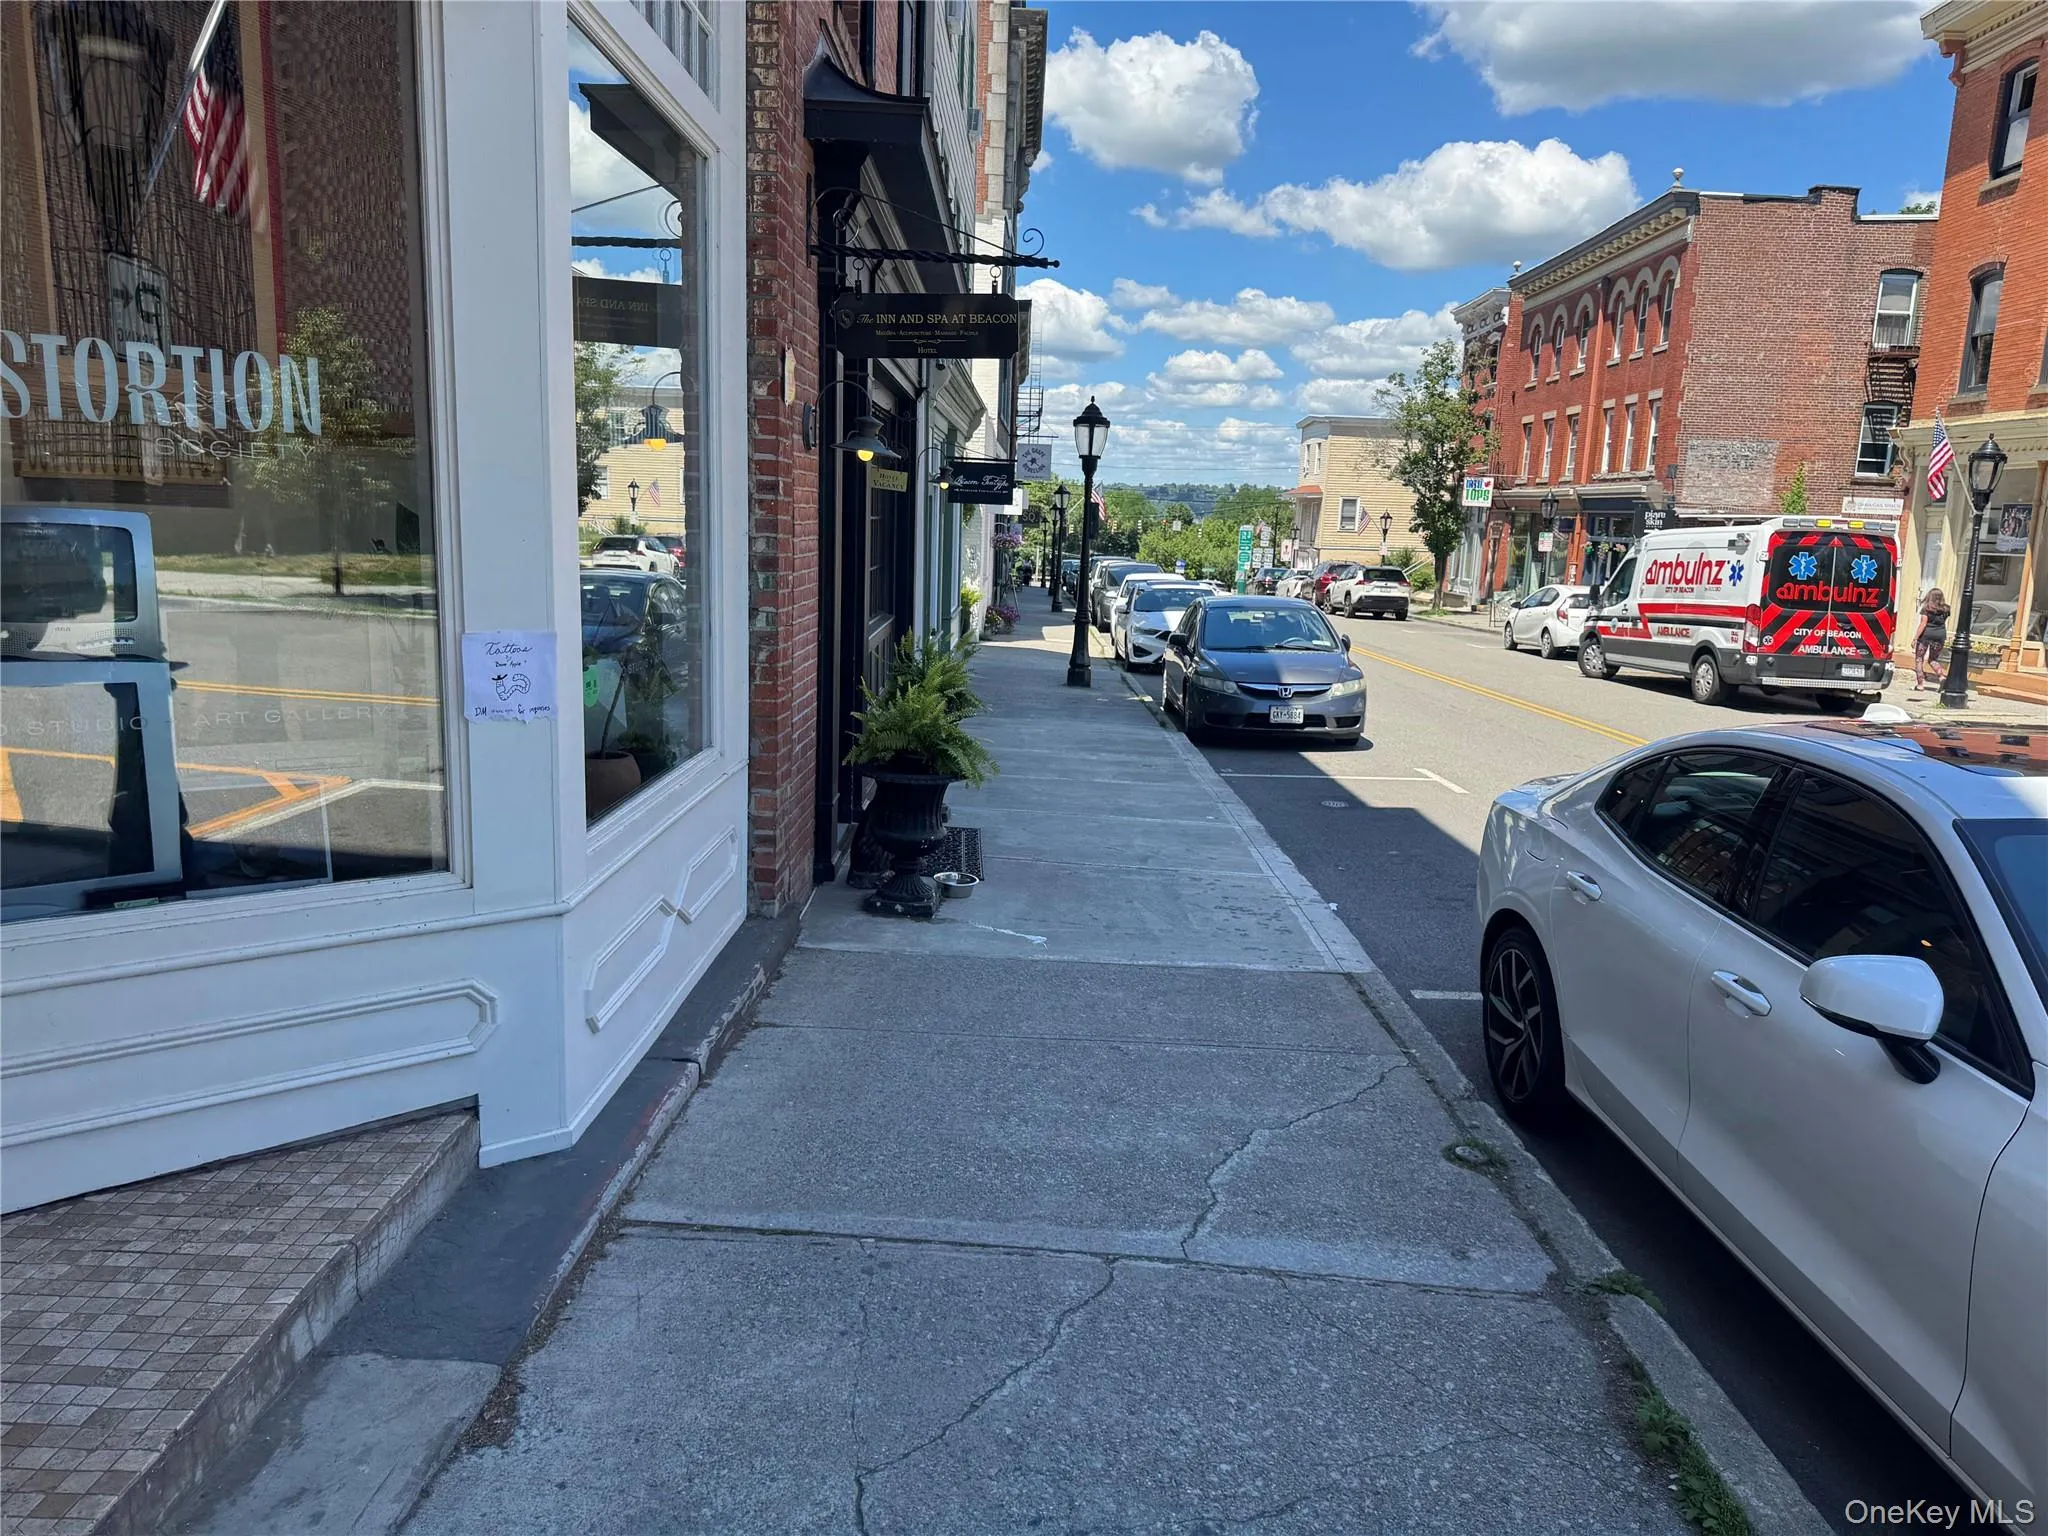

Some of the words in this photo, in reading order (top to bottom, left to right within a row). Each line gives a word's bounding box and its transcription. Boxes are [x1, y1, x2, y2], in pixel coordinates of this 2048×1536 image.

[856, 313, 875, 324] The
[876, 314, 896, 324] INN
[899, 314, 924, 324] AND
[926, 314, 947, 324] SPA
[949, 314, 966, 324] AT
[969, 313, 1017, 324] BEACON
[154, 437, 316, 460] SOCIETY
[1465, 488, 1490, 501] TOPS
[1645, 552, 1726, 585] ambulnz
[1776, 581, 1880, 603] ambulnz
[1793, 628, 1813, 637] CITY
[1814, 629, 1826, 637] OF
[1827, 629, 1862, 639] BEACON
[1797, 644, 1857, 656] AMBULANCE
[474, 706, 487, 717] DM
[27, 714, 148, 736] STUDIO
[193, 711, 249, 728] ART
[264, 705, 390, 724] GALLERY
